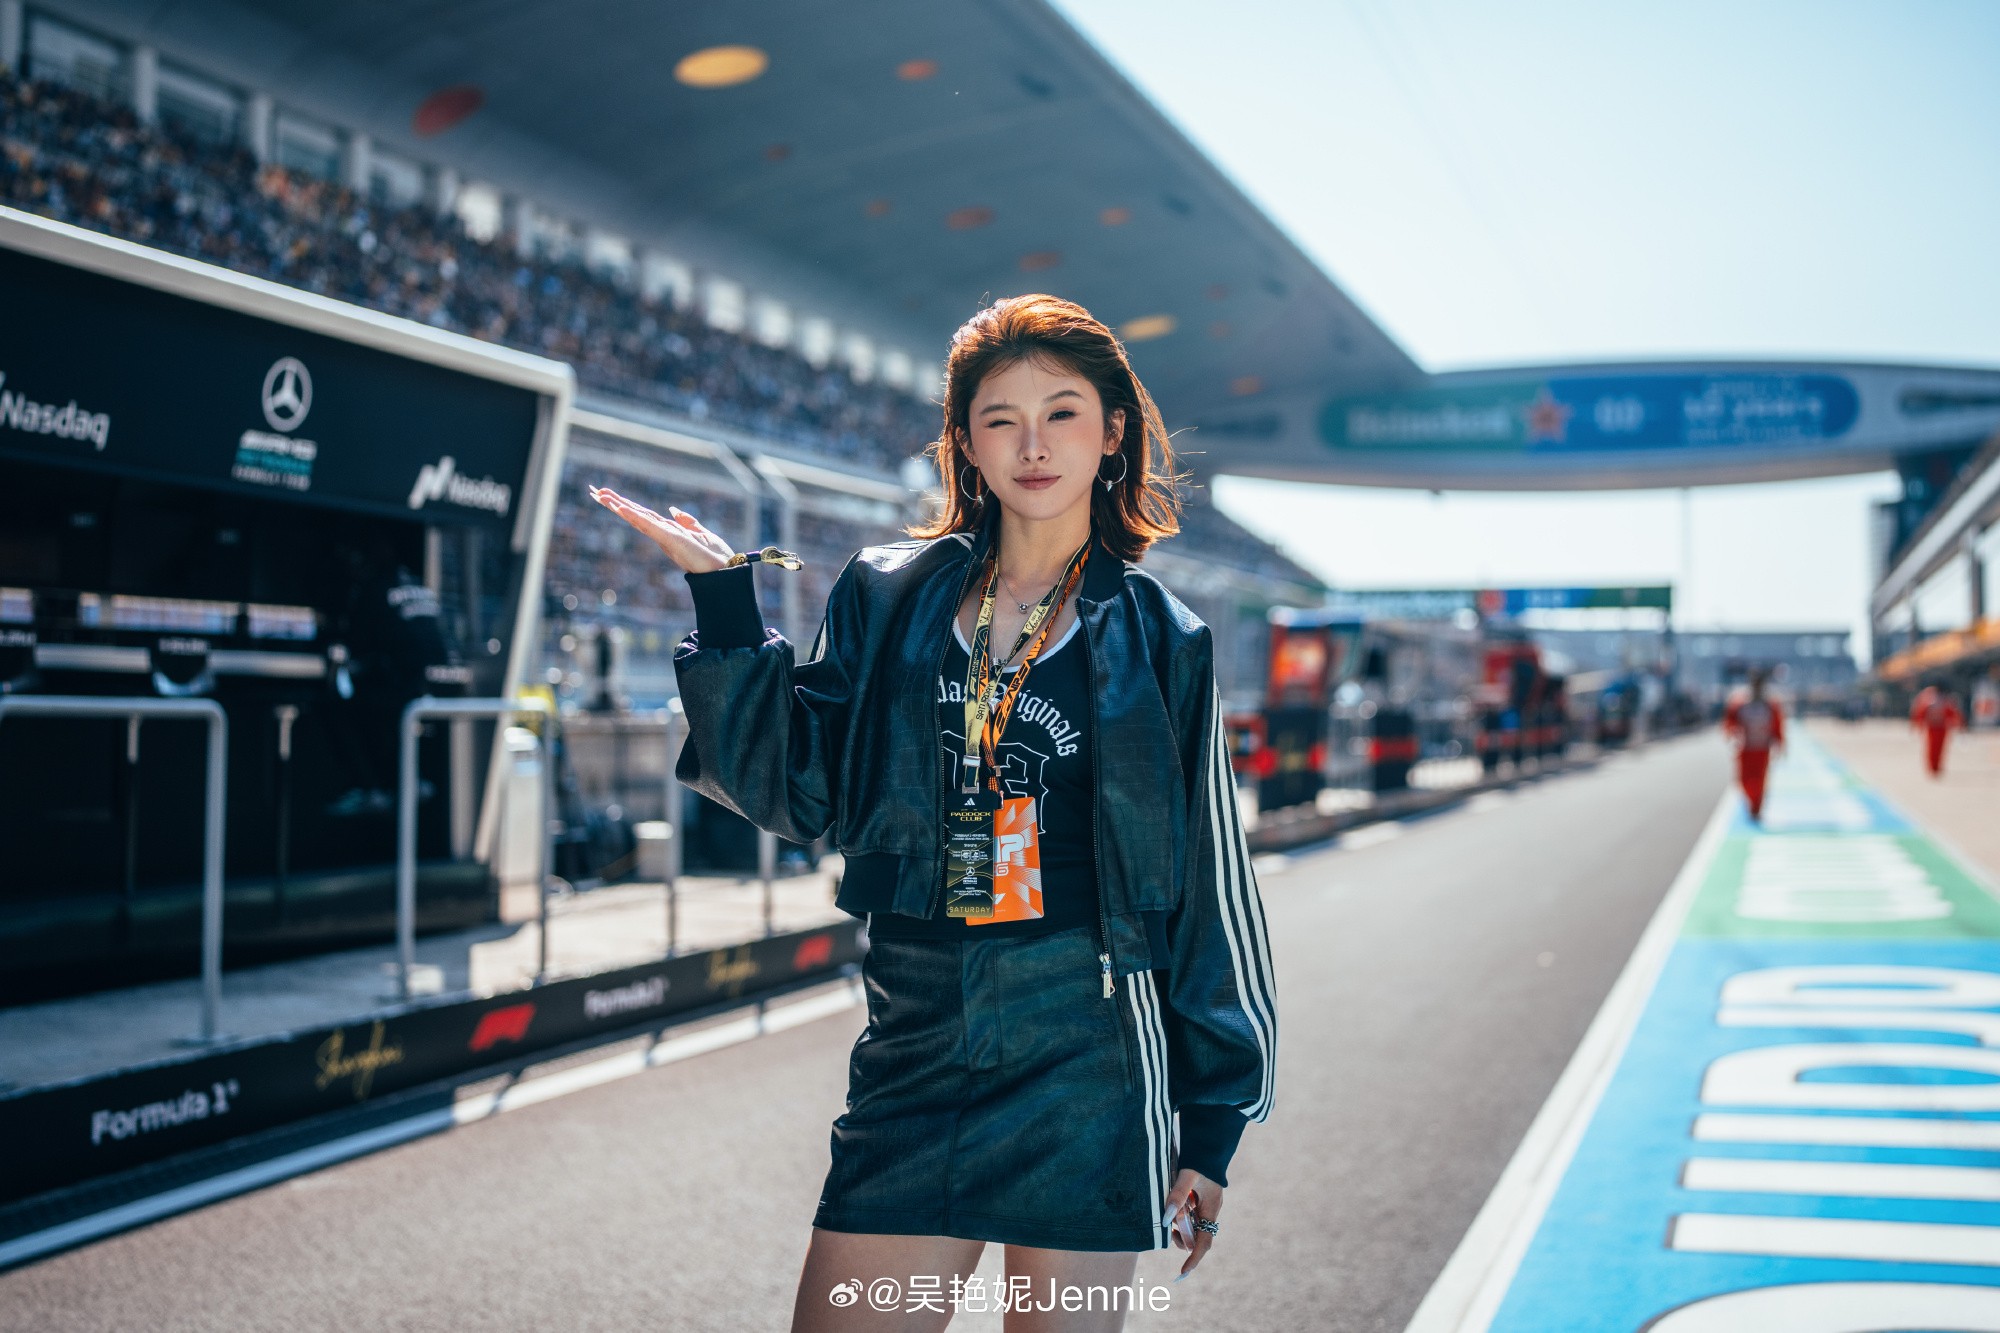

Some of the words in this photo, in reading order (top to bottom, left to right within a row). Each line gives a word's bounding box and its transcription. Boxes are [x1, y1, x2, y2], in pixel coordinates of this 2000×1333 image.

[0, 389, 110, 452] Nasdaq
[1009, 677, 1022, 693] VIP
[91, 1088, 207, 1145] Formula
